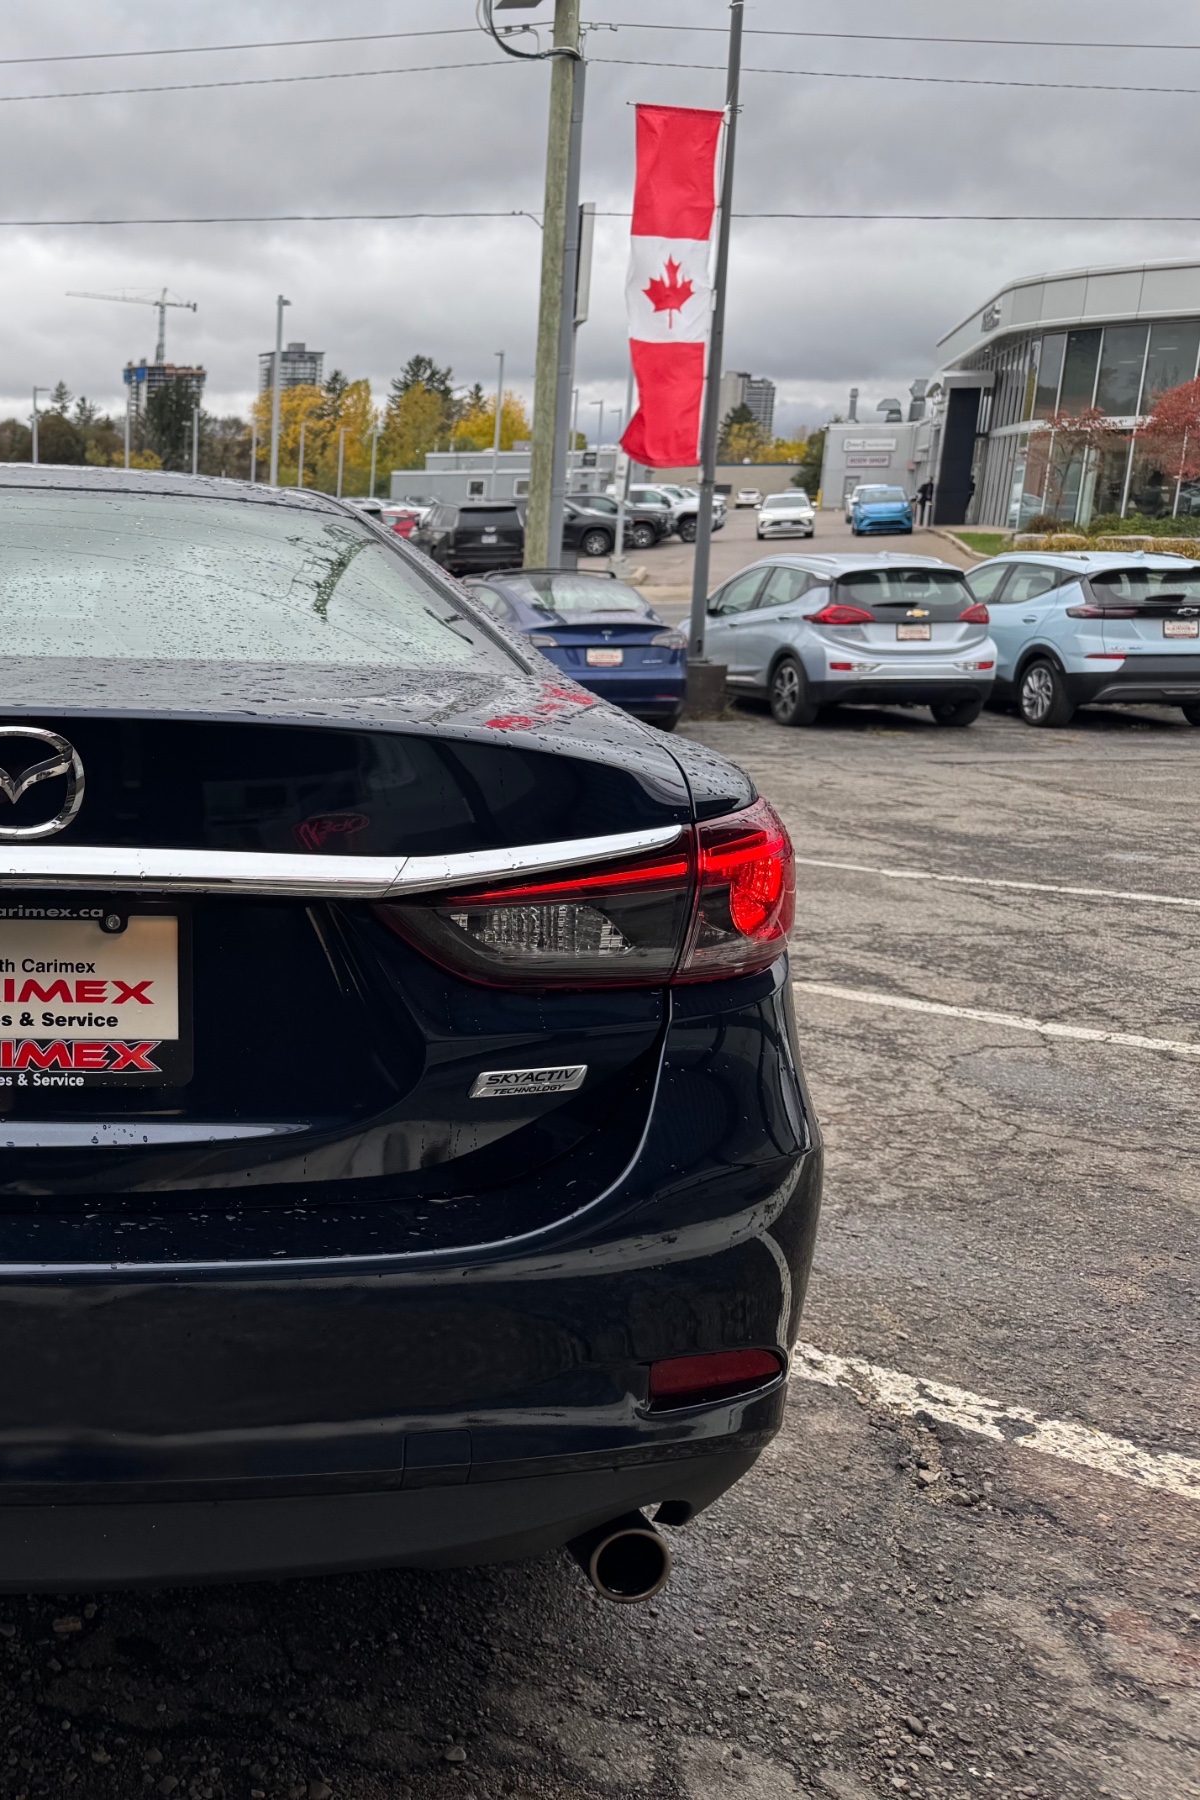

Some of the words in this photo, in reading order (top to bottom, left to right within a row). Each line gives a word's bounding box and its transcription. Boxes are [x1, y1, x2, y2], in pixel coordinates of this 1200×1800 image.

[21, 958, 96, 974] Carimex
[19, 1012, 35, 1027] &
[41, 1012, 119, 1028] Service
[18, 1073, 28, 1087] &
[33, 1072, 85, 1087] Service
[486, 1068, 578, 1086] SKYACTIV
[492, 1083, 566, 1095] TECHNOLOGY
